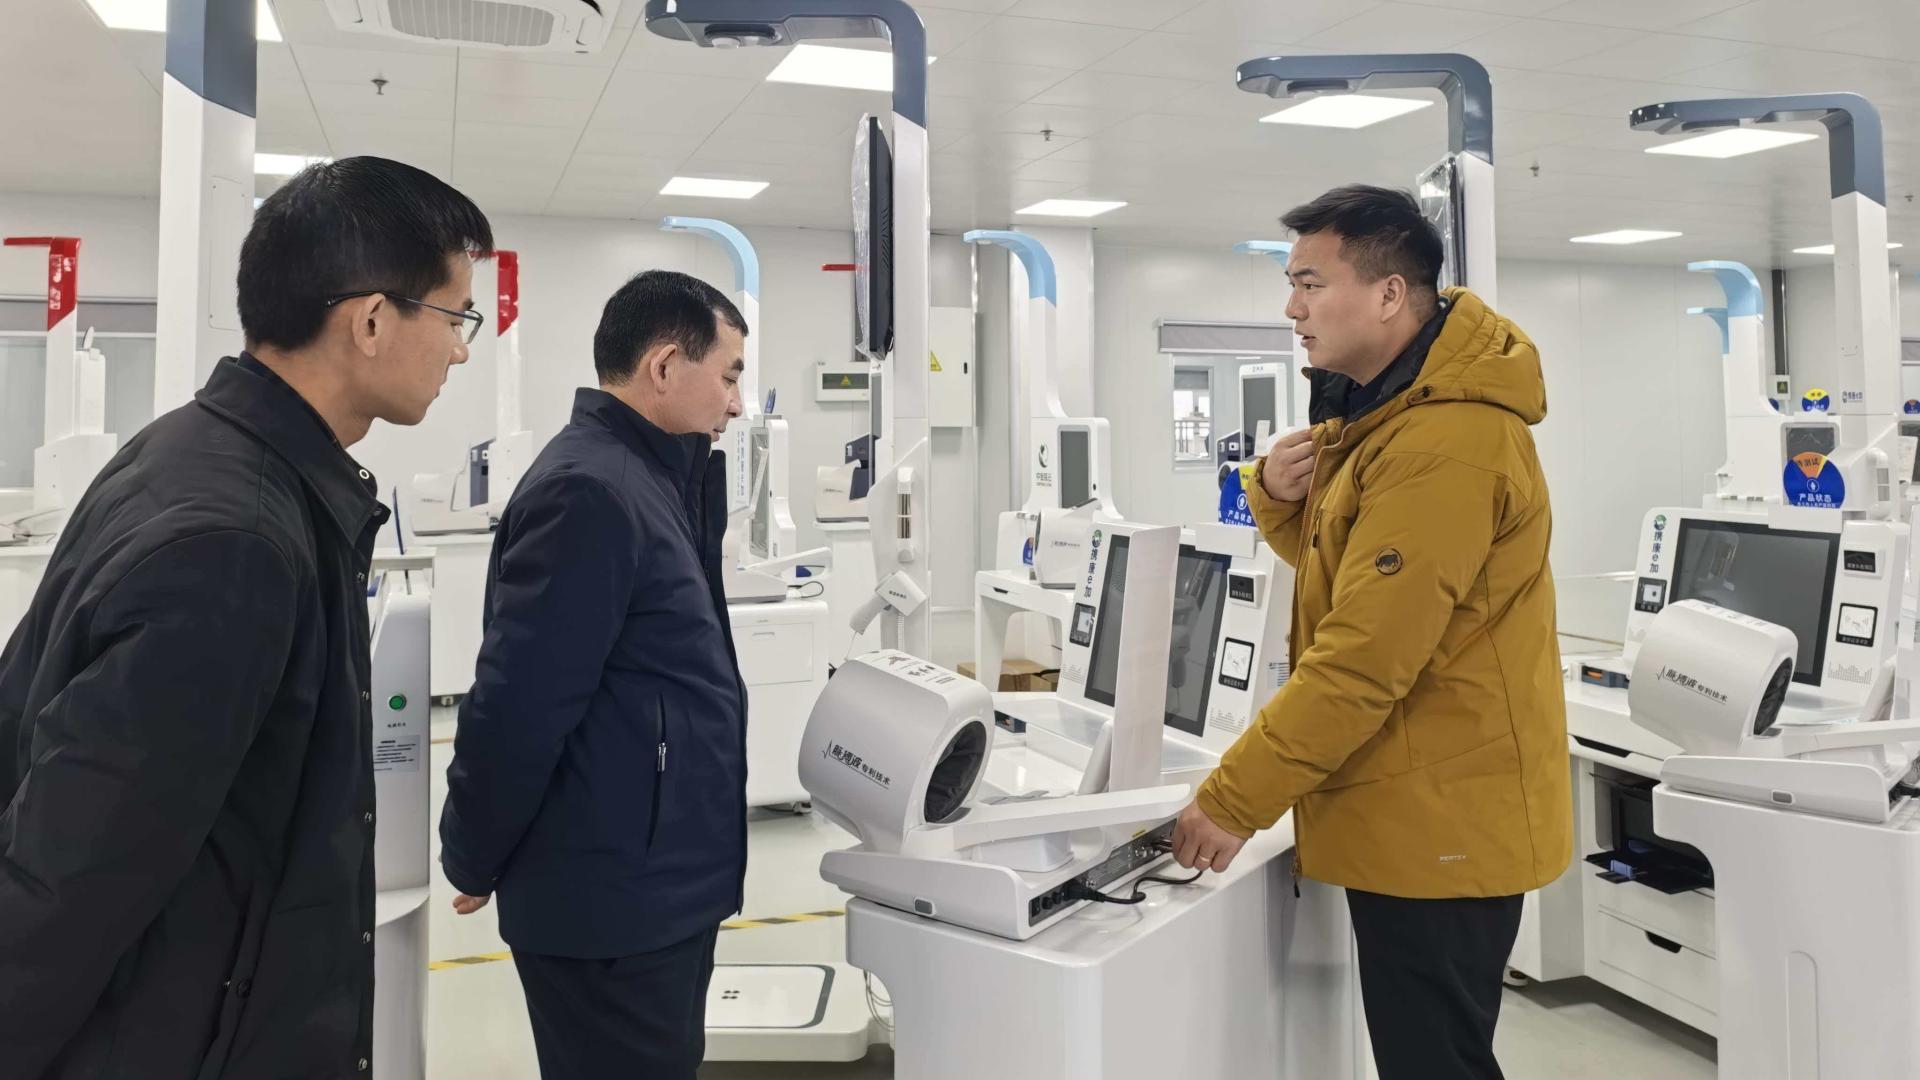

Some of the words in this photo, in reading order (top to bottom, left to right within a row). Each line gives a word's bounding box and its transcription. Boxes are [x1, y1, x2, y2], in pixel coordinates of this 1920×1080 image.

[1799, 493, 1832, 503] 产品状态
[1228, 509, 1252, 524] 产品状态
[1649, 531, 1663, 574] 携康e加
[1084, 548, 1098, 598] 携康e加
[1697, 684, 1728, 702] 专利技术
[862, 763, 891, 785] 专利技术
